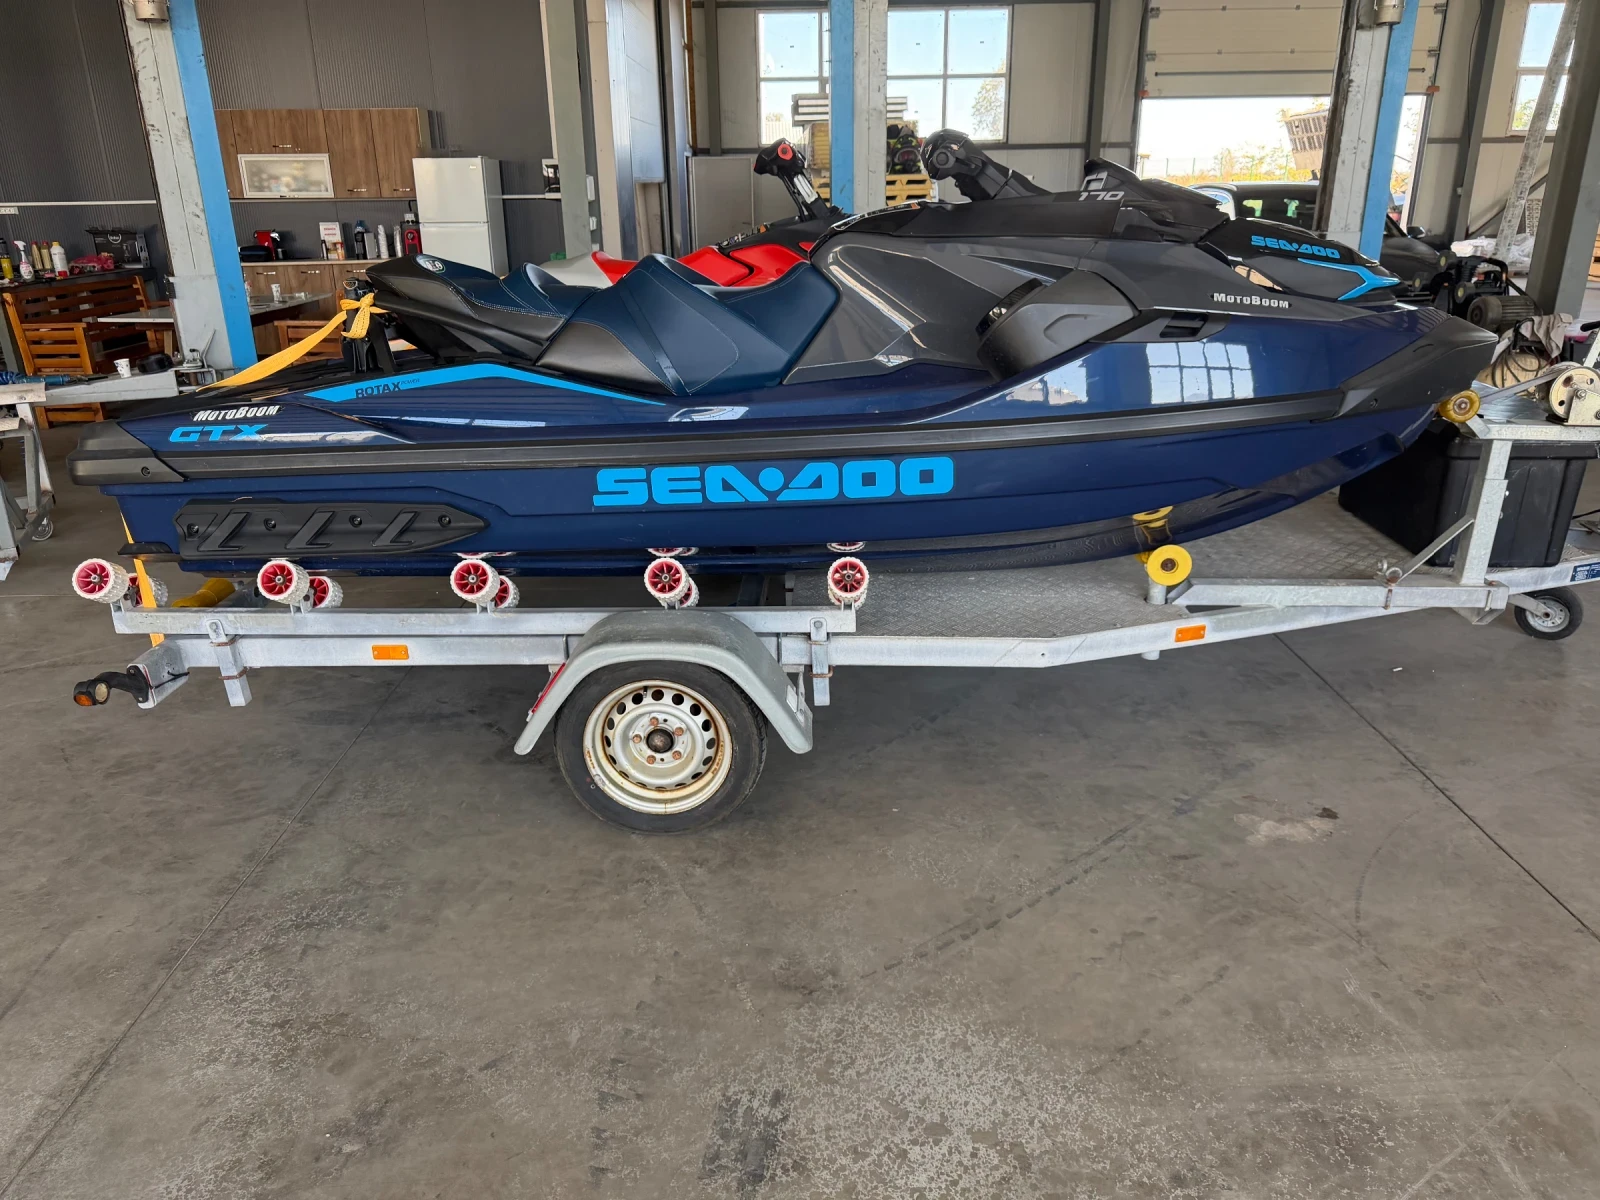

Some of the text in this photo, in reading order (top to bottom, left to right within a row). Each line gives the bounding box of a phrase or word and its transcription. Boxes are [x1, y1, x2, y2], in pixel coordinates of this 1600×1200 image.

[1078, 191, 1125, 201] 170
[355, 381, 402, 399] ROTAX
[168, 423, 269, 443] GTX
